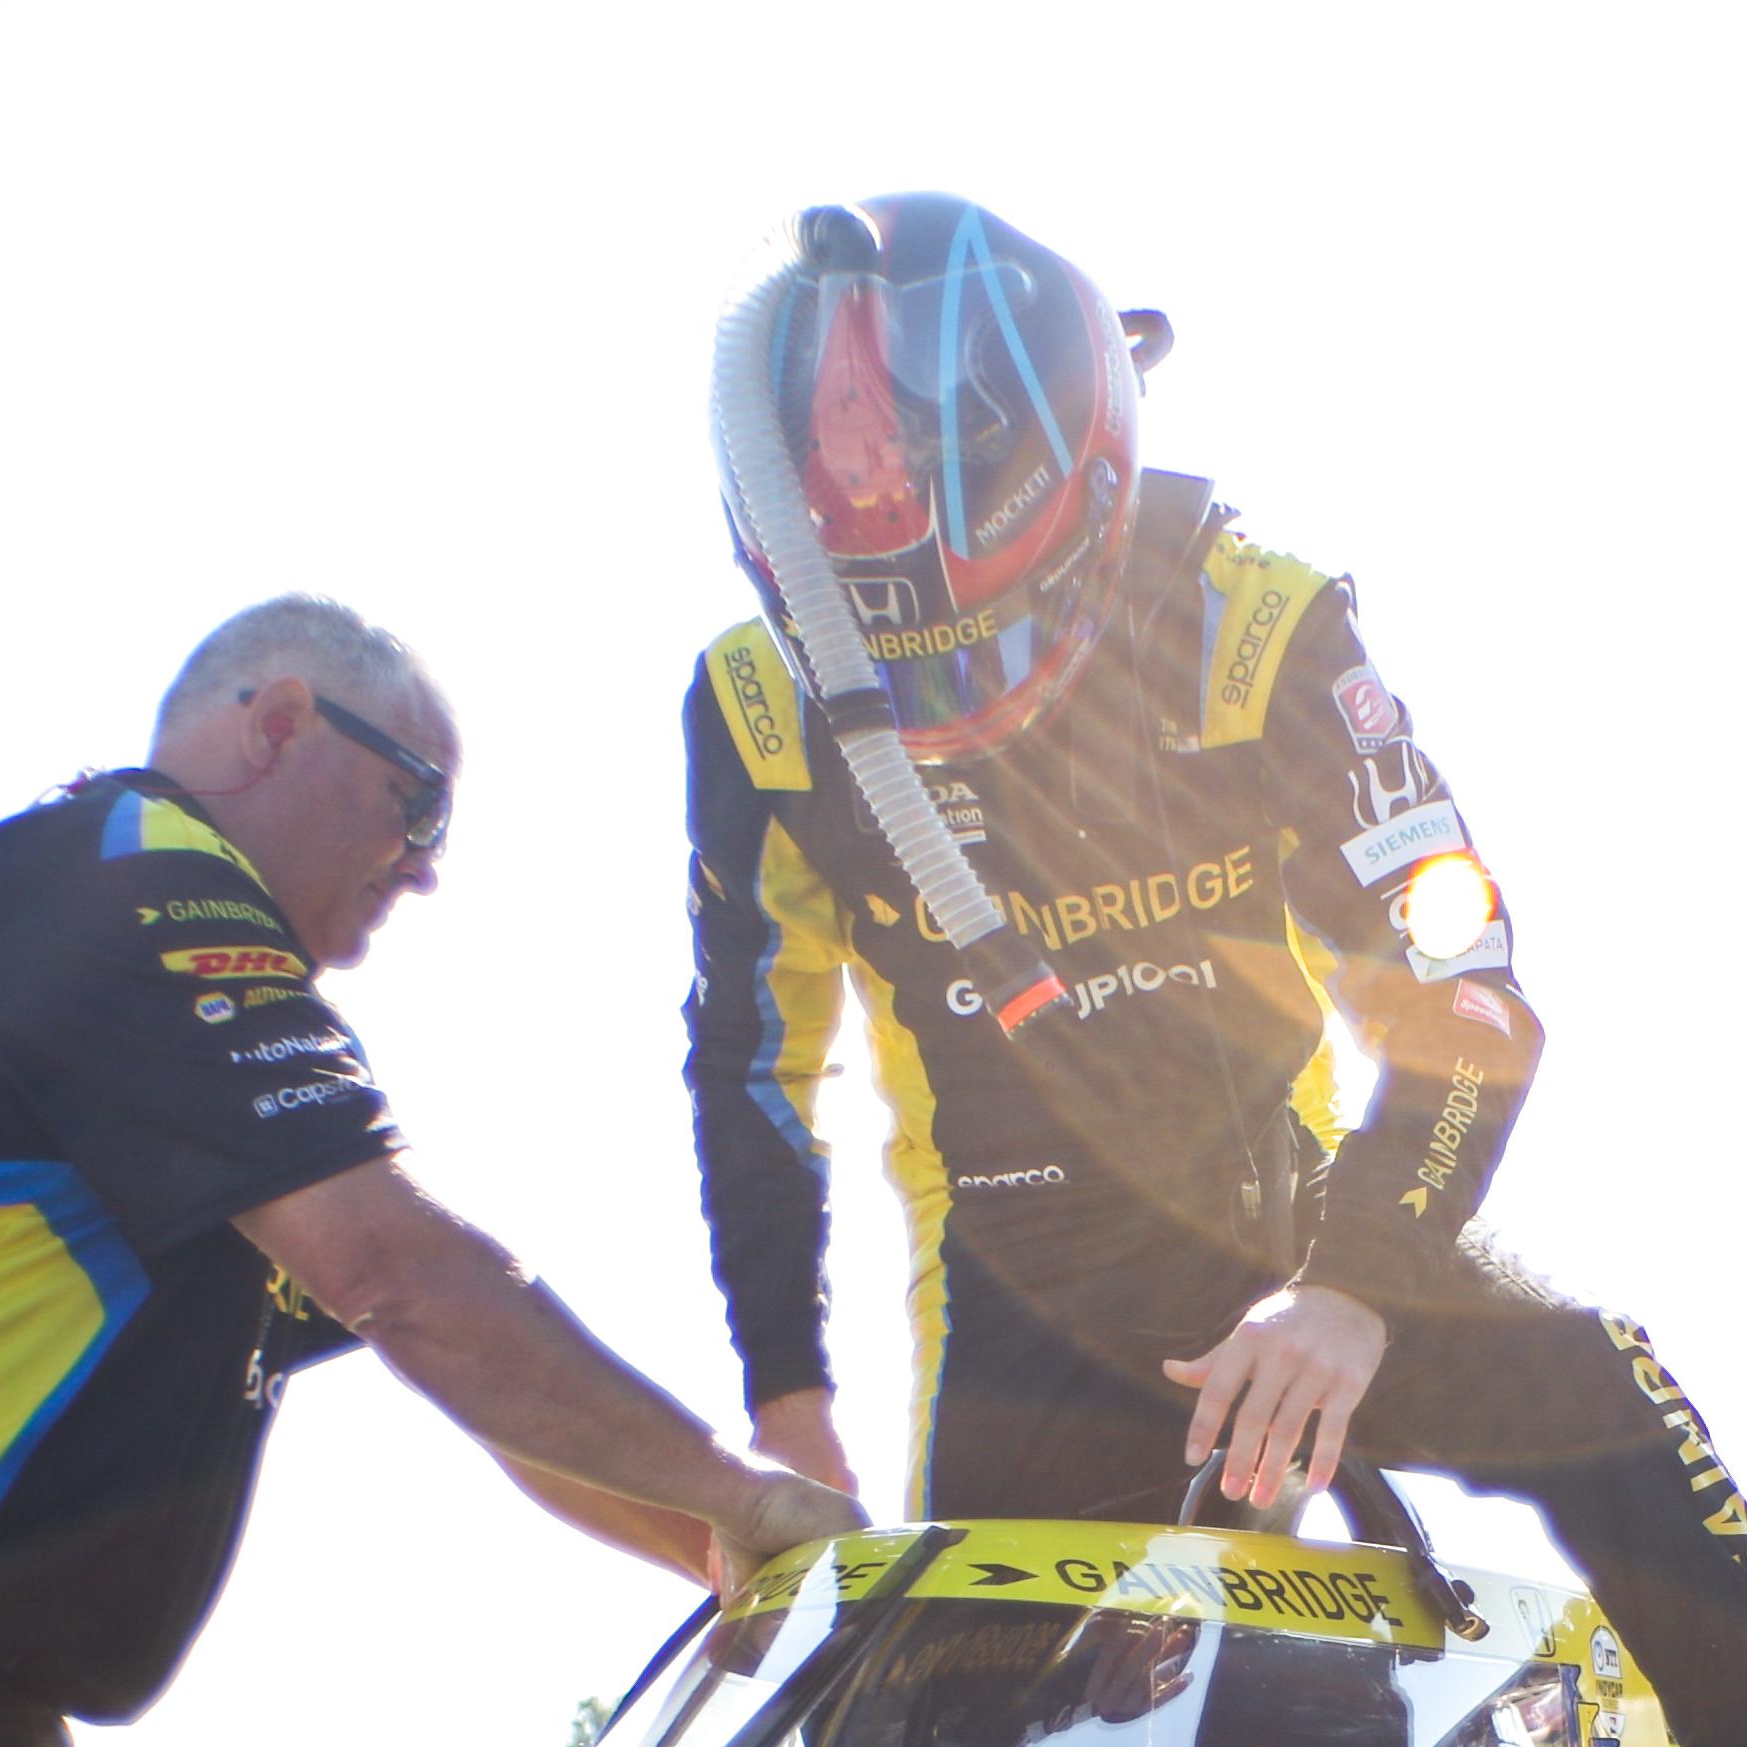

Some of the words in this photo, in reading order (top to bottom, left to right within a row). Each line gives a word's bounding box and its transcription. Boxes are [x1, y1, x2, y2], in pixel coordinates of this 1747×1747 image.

[861, 608, 998, 661] NBRIDGE
[1221, 589, 1284, 708] sparco
[726, 643, 785, 758] sparco
[1363, 816, 1452, 866] SIEMENS
[914, 845, 1254, 951] GNBRIDGE
[189, 951, 291, 977] DHL
[1416, 1056, 1484, 1191] GAINBRIDGE
[1054, 1558, 1404, 1628] GAINBRIDGE
